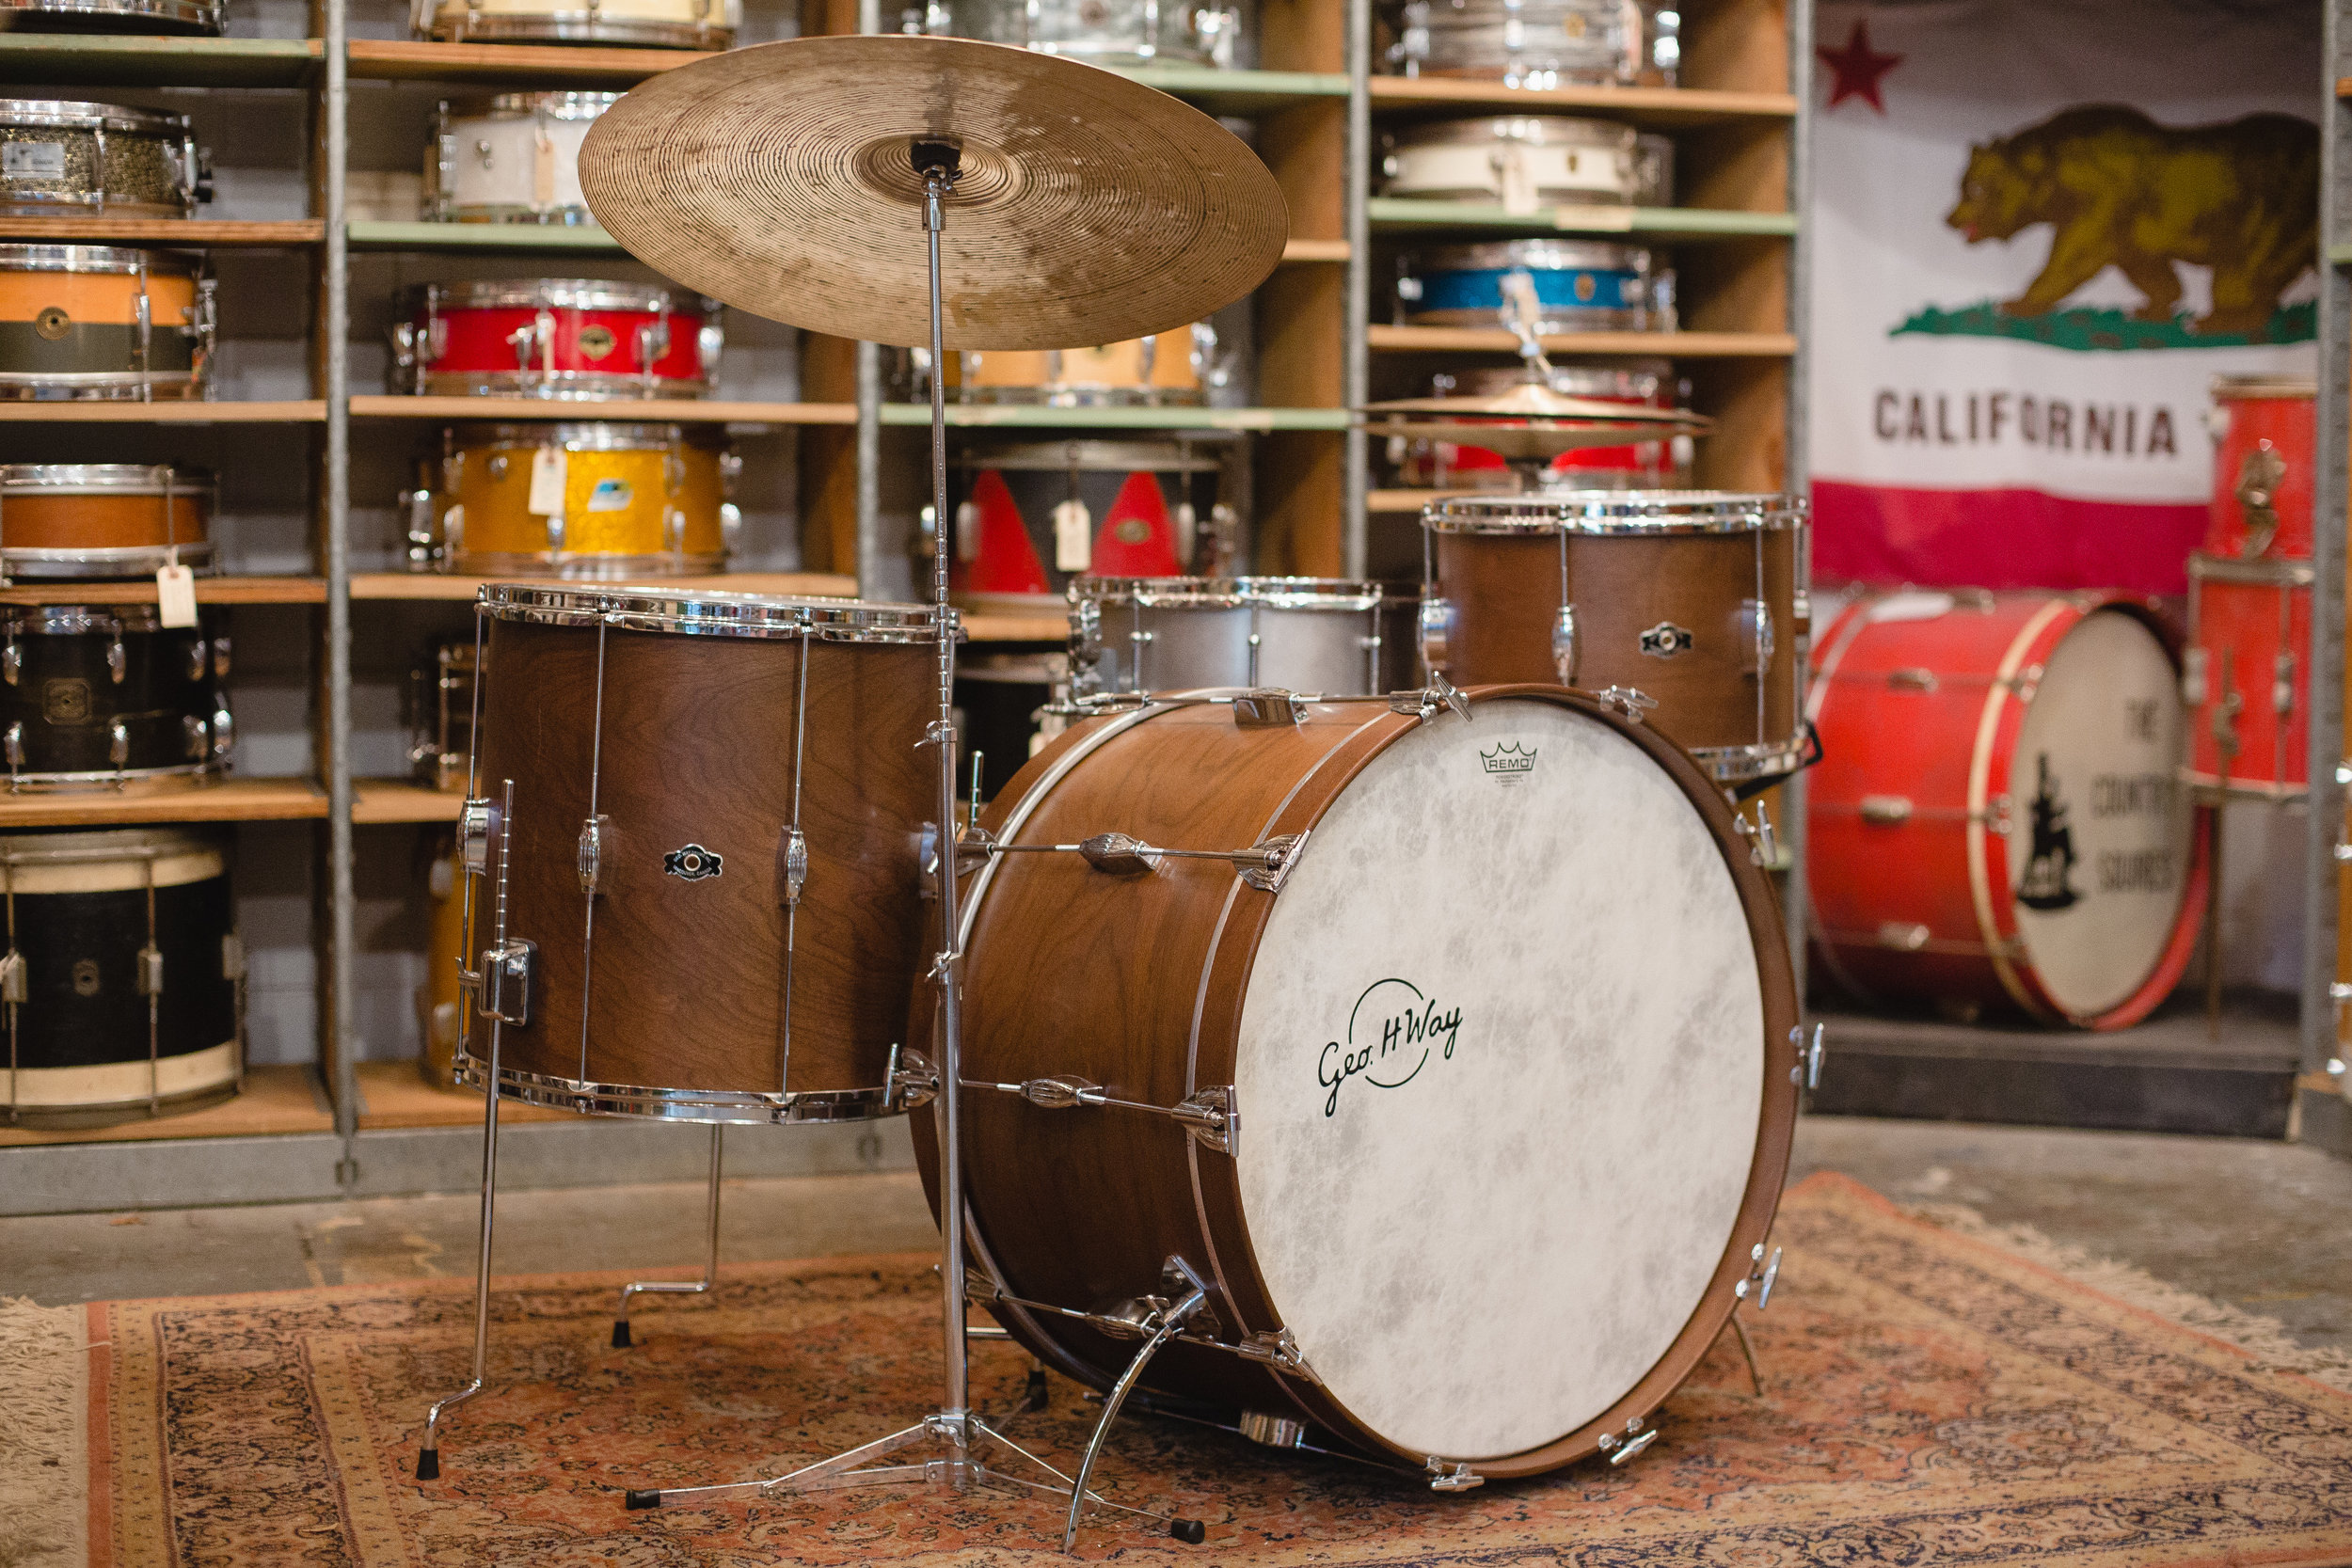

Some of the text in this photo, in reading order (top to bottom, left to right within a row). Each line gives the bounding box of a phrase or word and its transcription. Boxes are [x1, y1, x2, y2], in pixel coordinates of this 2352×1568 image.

[1874, 389, 2178, 456] CALIFORNIA
[1488, 758, 1529, 769] REMO
[1381, 1016, 1402, 1058] H
[1405, 999, 1463, 1060] Way
